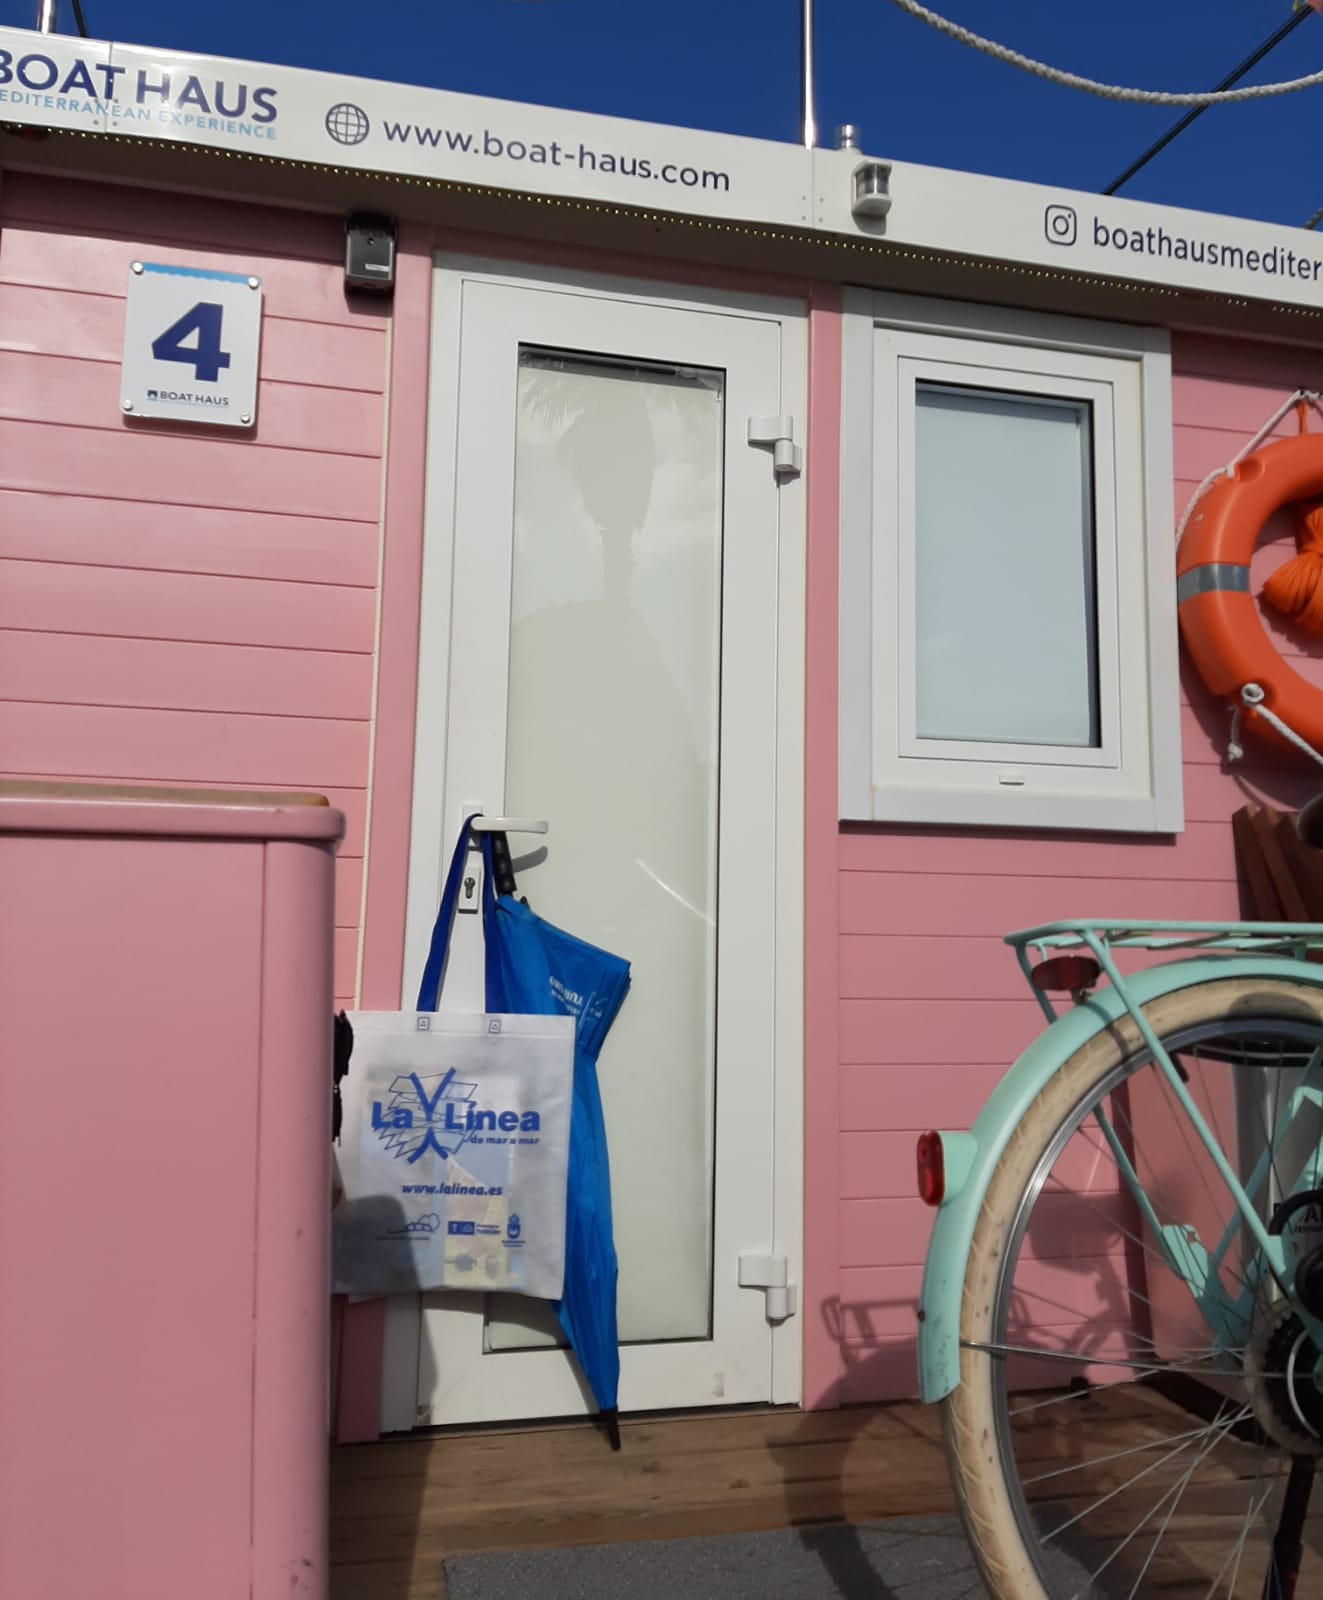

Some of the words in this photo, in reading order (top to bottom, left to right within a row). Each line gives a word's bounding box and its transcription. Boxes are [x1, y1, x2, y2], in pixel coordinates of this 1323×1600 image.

[136, 70, 278, 123] HAUS
[158, 111, 277, 140] EXPERIENCE
[383, 121, 730, 191] www.boat-haus.com
[1093, 216, 1322, 281] boathausmediter
[151, 302, 231, 383] 4
[160, 391, 193, 402] BOAT
[195, 394, 229, 406] HAUS
[371, 1102, 413, 1129] La
[470, 1134, 484, 1144] de
[486, 1137, 508, 1145] mar
[518, 1137, 540, 1145] mar
[402, 1182, 503, 1196] www.lalinea.es
